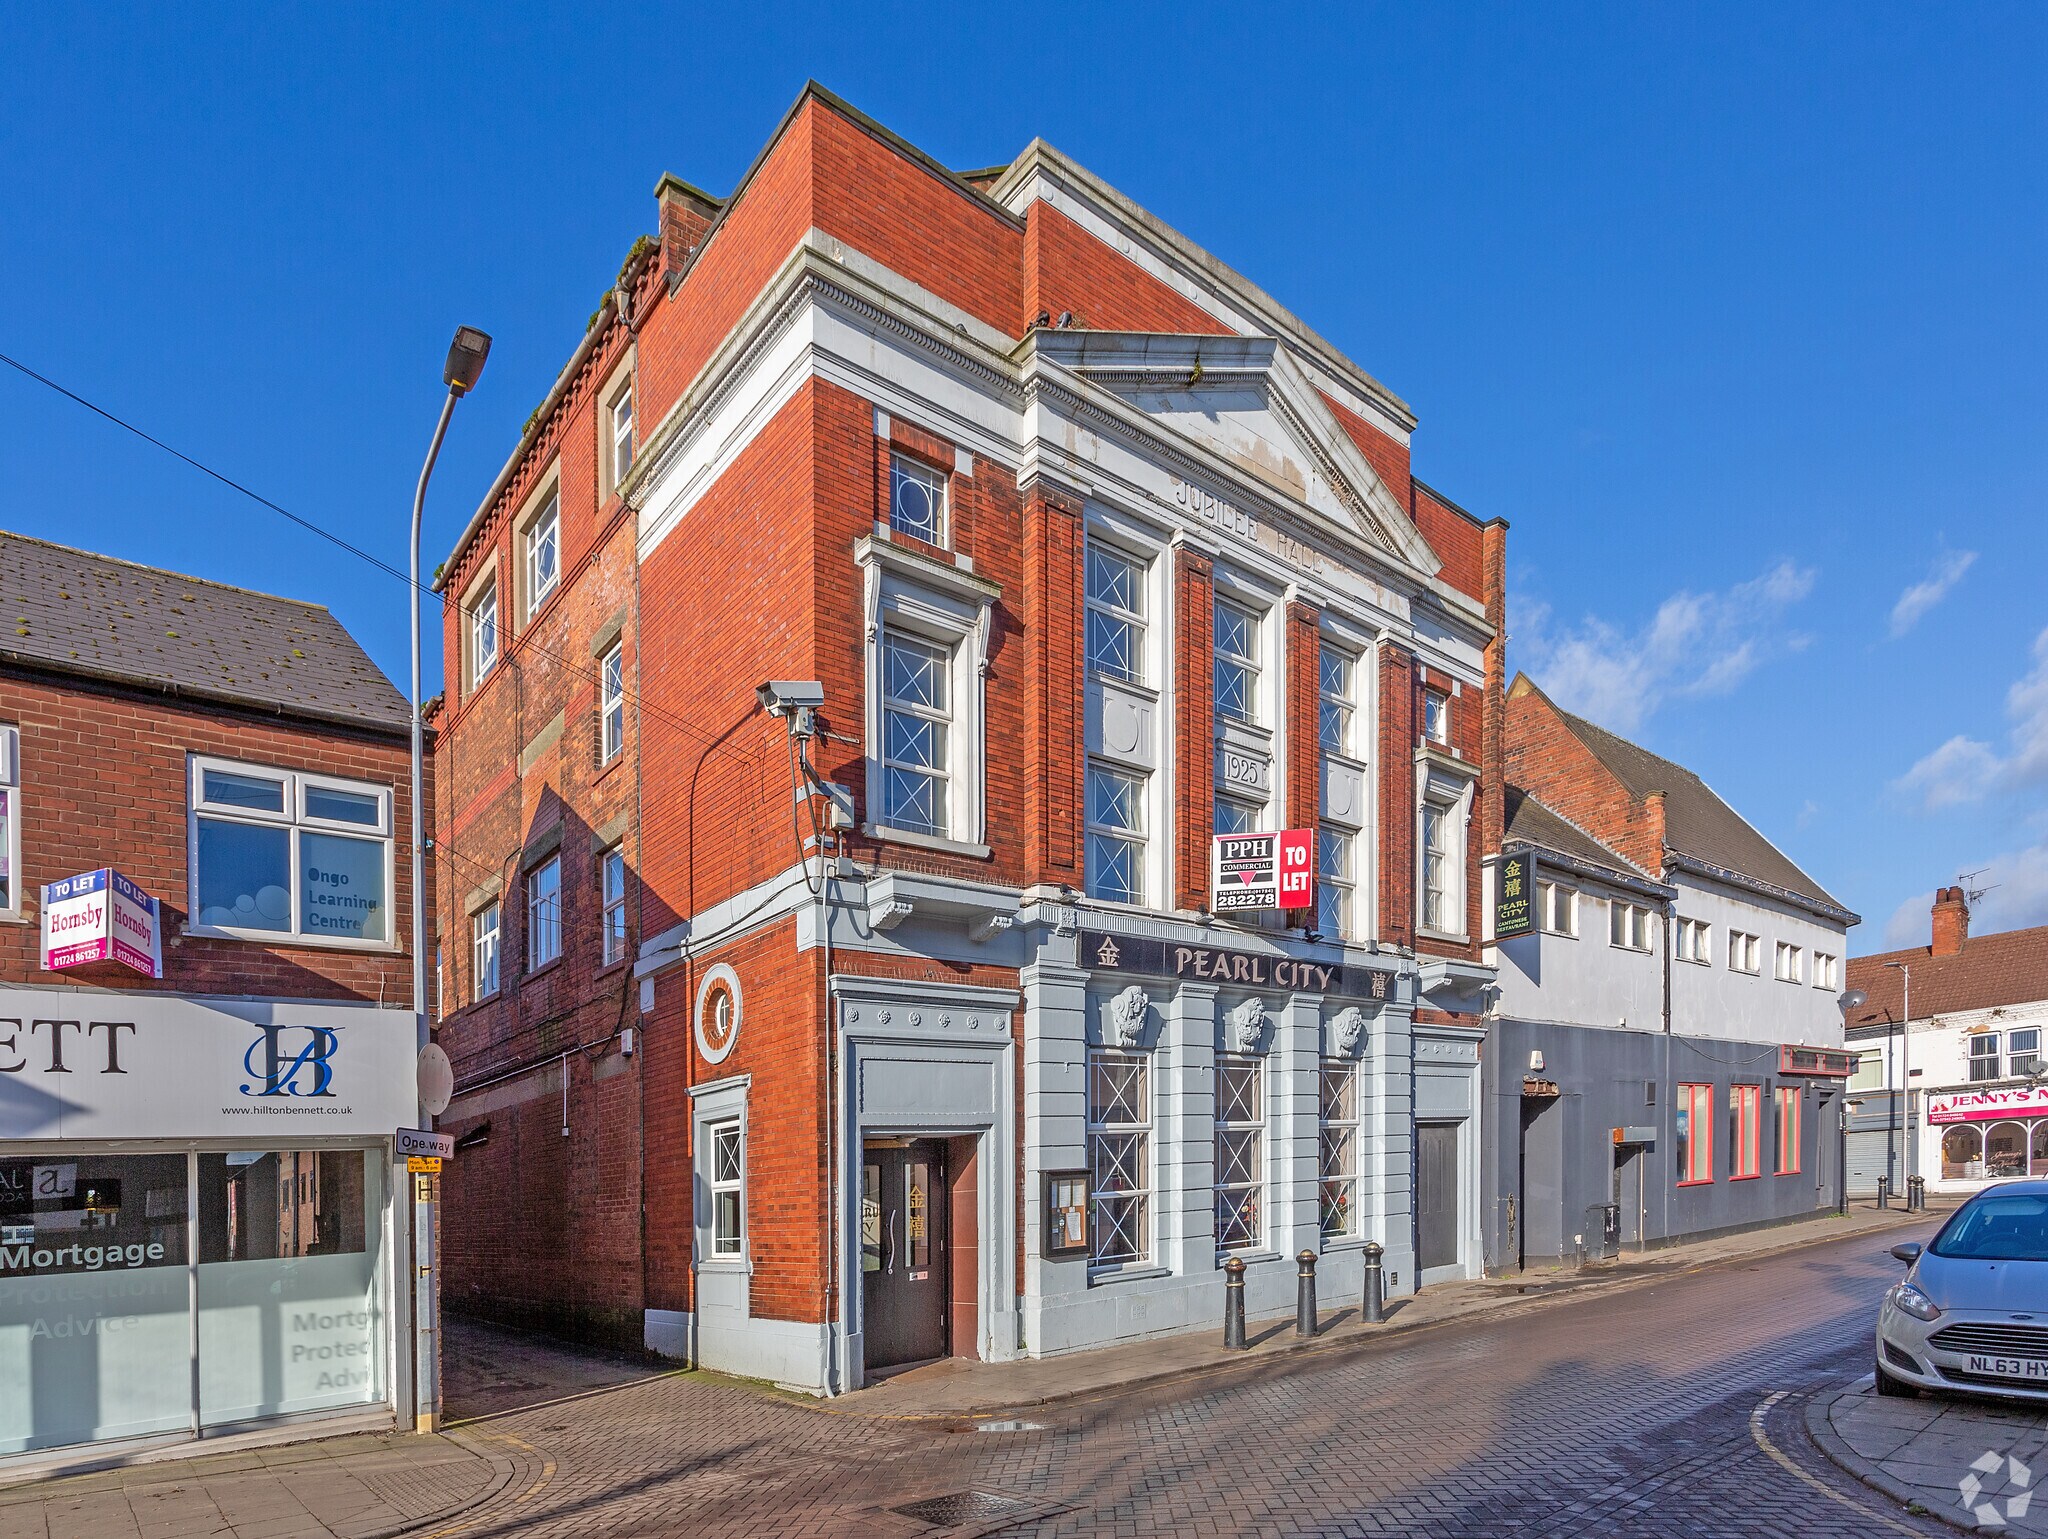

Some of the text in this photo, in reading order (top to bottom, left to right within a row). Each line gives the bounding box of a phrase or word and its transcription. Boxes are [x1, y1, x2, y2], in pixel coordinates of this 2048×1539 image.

[1176, 482, 1257, 541] JUBILEE
[1226, 755, 1258, 784] 1925
[1226, 840, 1268, 858] PPH
[1285, 846, 1306, 866] TO
[1222, 862, 1271, 871] COMMERCIAL
[55, 875, 96, 897] TO LET
[308, 867, 349, 887] Ongo
[1283, 871, 1308, 892] LET
[117, 876, 147, 907] TO LET
[1217, 893, 1275, 906] 282278
[309, 890, 377, 913] Learning
[1497, 899, 1529, 912] PEARL
[51, 902, 103, 933] Hornsby
[309, 912, 361, 930] Centre
[1498, 916, 1528, 927] CANTONESE
[1501, 907, 1524, 919] CITY
[114, 902, 152, 947] Hornsby
[1496, 921, 1529, 933] RESTAURANT
[54, 954, 74, 967] 01724
[75, 948, 100, 962] 861257
[117, 948, 133, 965] 01724
[1175, 947, 1335, 990] PEARL CITY
[1951, 1091, 2031, 1109] JENNY'S
[221, 1105, 353, 1116] www.hilltonbennett.co.uk
[402, 1135, 450, 1154] One way
[0, 1242, 165, 1270] Mortgage
[30, 1311, 140, 1341] Advice
[1970, 1356, 2020, 1374] NL63
